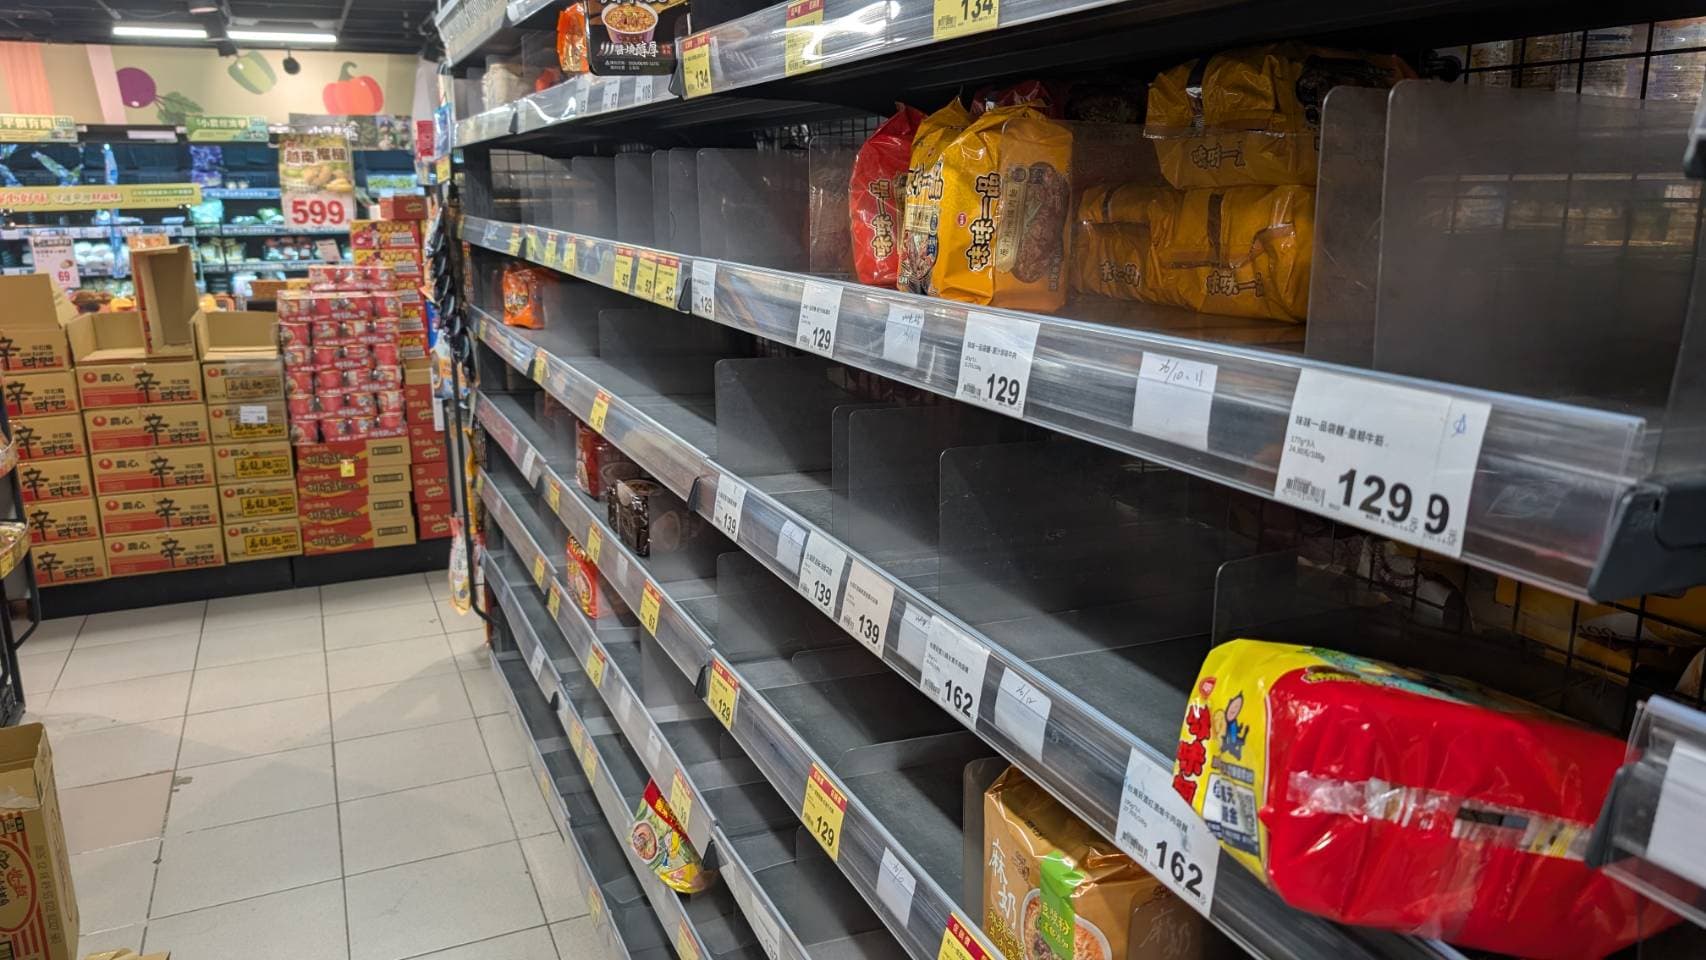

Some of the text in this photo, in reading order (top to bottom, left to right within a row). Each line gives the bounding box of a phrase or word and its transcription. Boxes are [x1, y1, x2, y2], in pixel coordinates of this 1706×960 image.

[292, 201, 345, 225] 599
[966, 172, 1001, 271] 味味一品
[812, 326, 832, 350] 129
[987, 373, 1020, 406] 129
[1338, 468, 1450, 535] 129 9
[723, 513, 737, 536] 139
[814, 580, 832, 607] 139
[858, 614, 880, 645] 139
[718, 698, 731, 721] 129
[945, 679, 974, 718] 162
[816, 815, 834, 847] 129
[1157, 839, 1204, 896] 162
